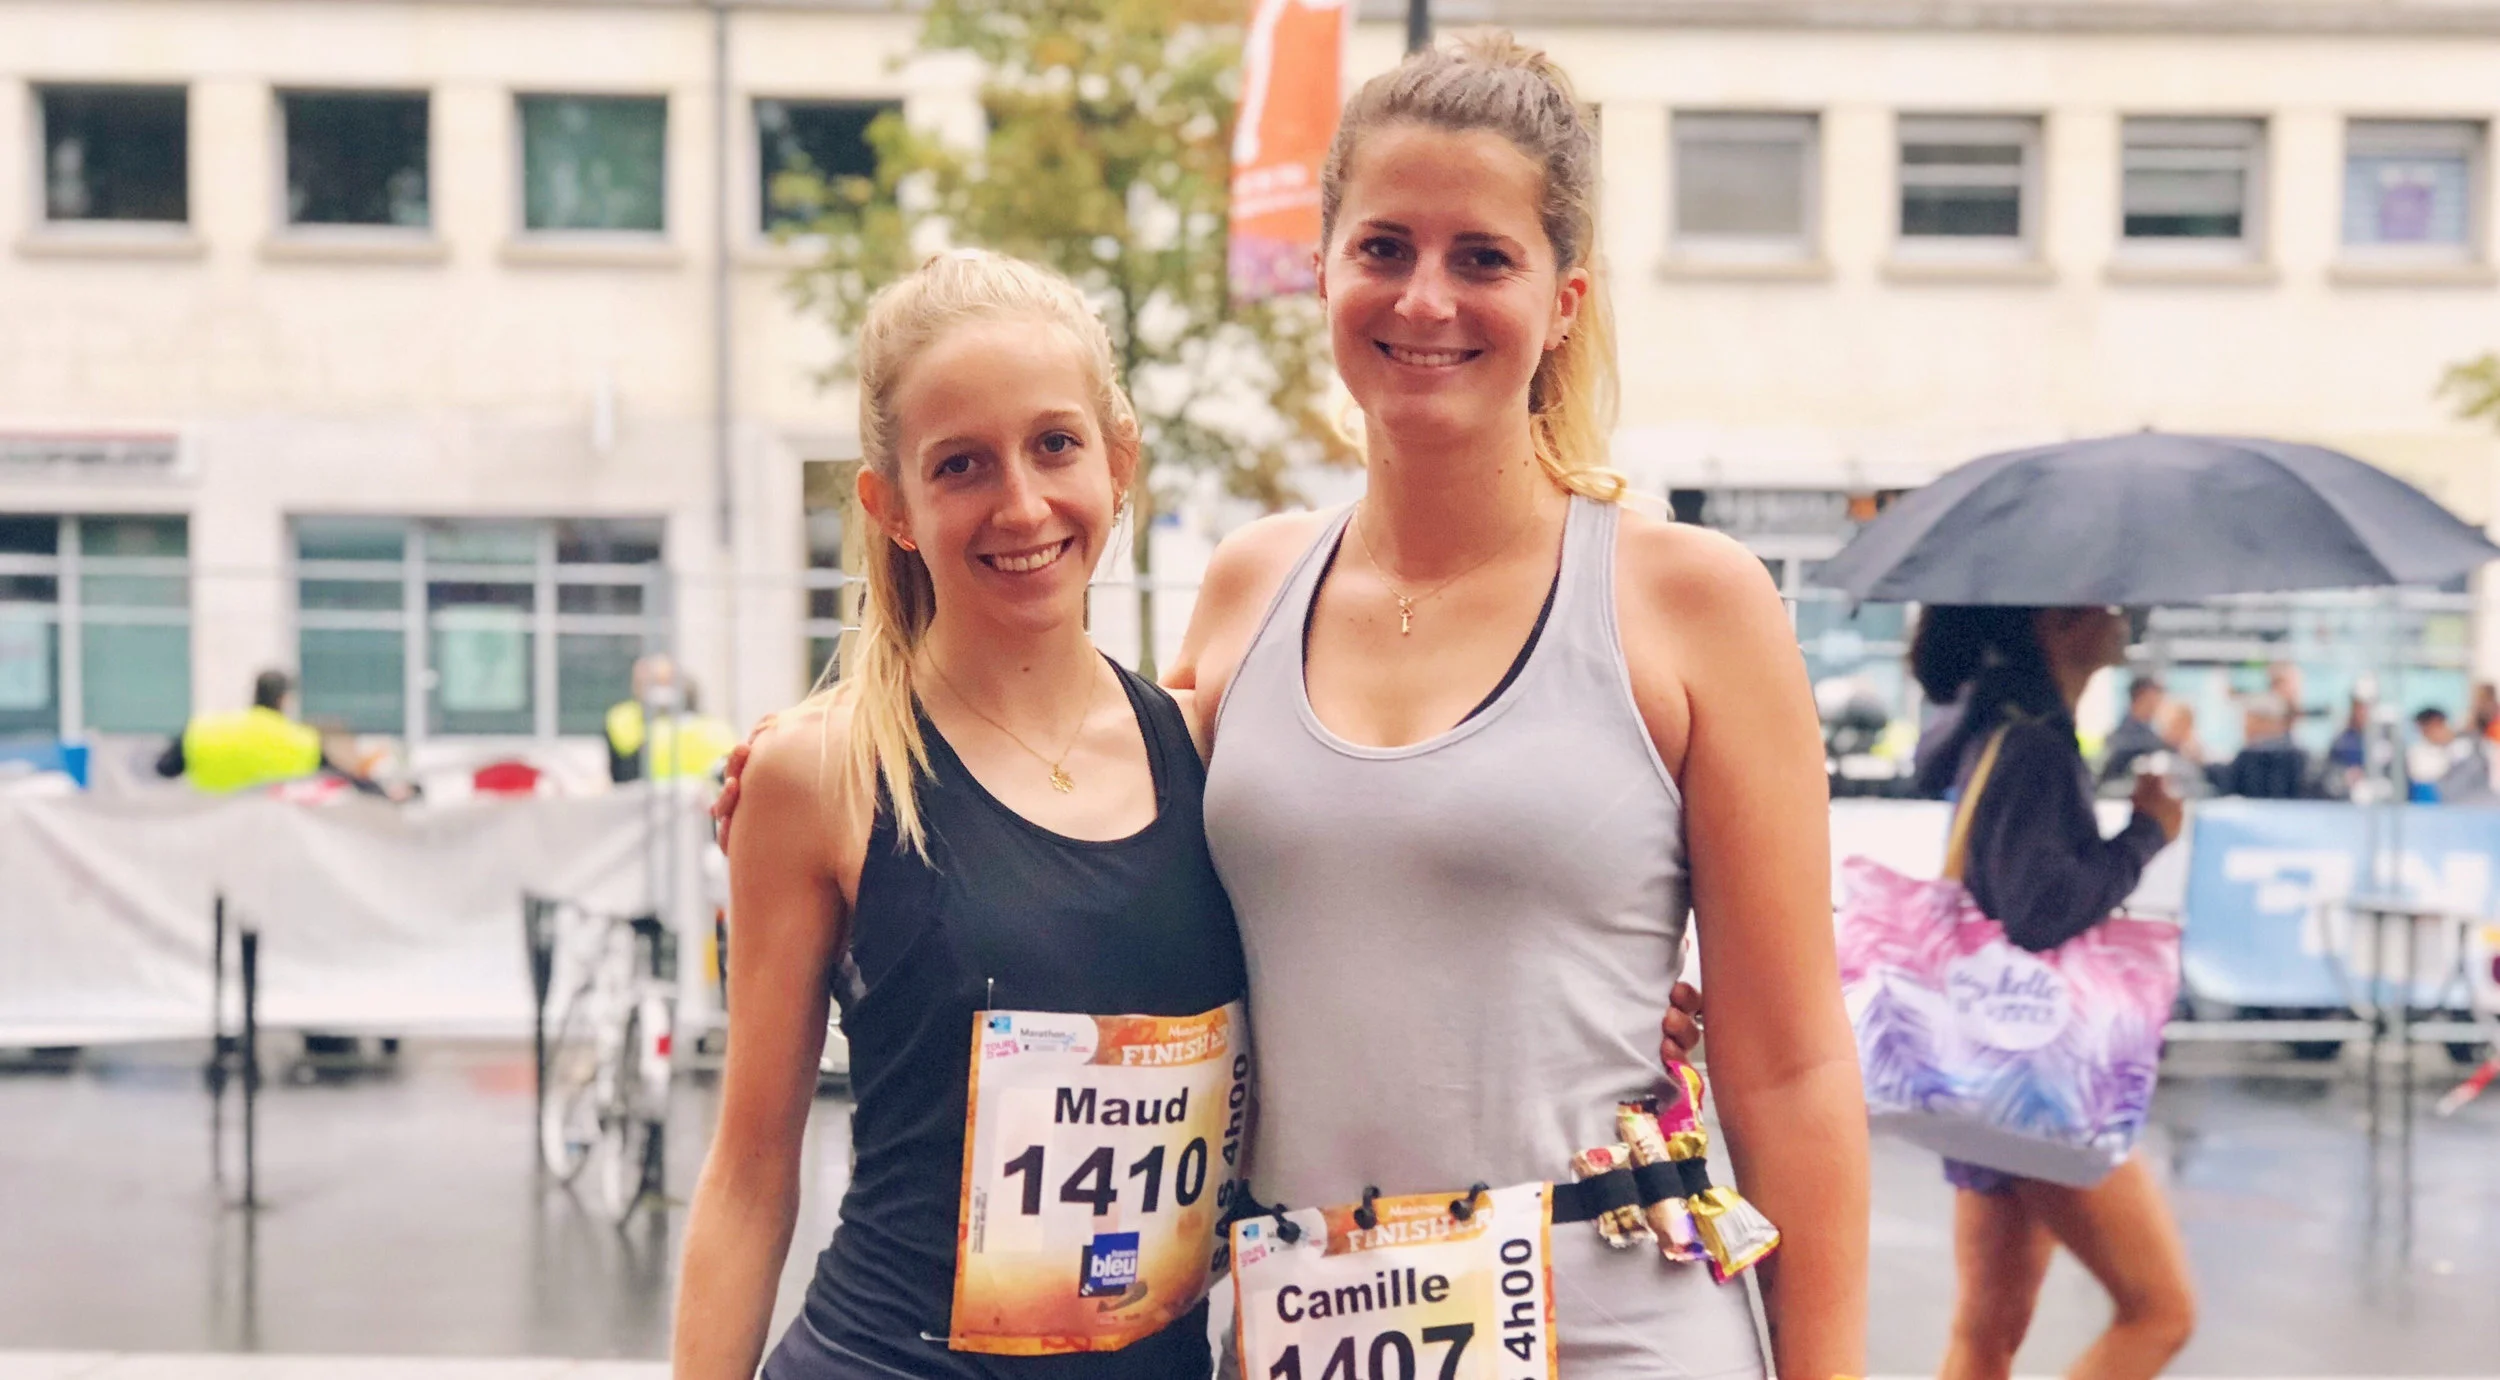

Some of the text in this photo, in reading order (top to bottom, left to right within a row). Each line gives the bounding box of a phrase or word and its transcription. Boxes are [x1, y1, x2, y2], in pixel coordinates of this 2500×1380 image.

[1055, 1086, 1189, 1126] Maud
[1222, 1053, 1248, 1166] 4h00
[1003, 1136, 1208, 1217] 1410
[1091, 1253, 1136, 1278] bleu
[1276, 1268, 1450, 1324] Camille
[1500, 1238, 1537, 1362] 4h00
